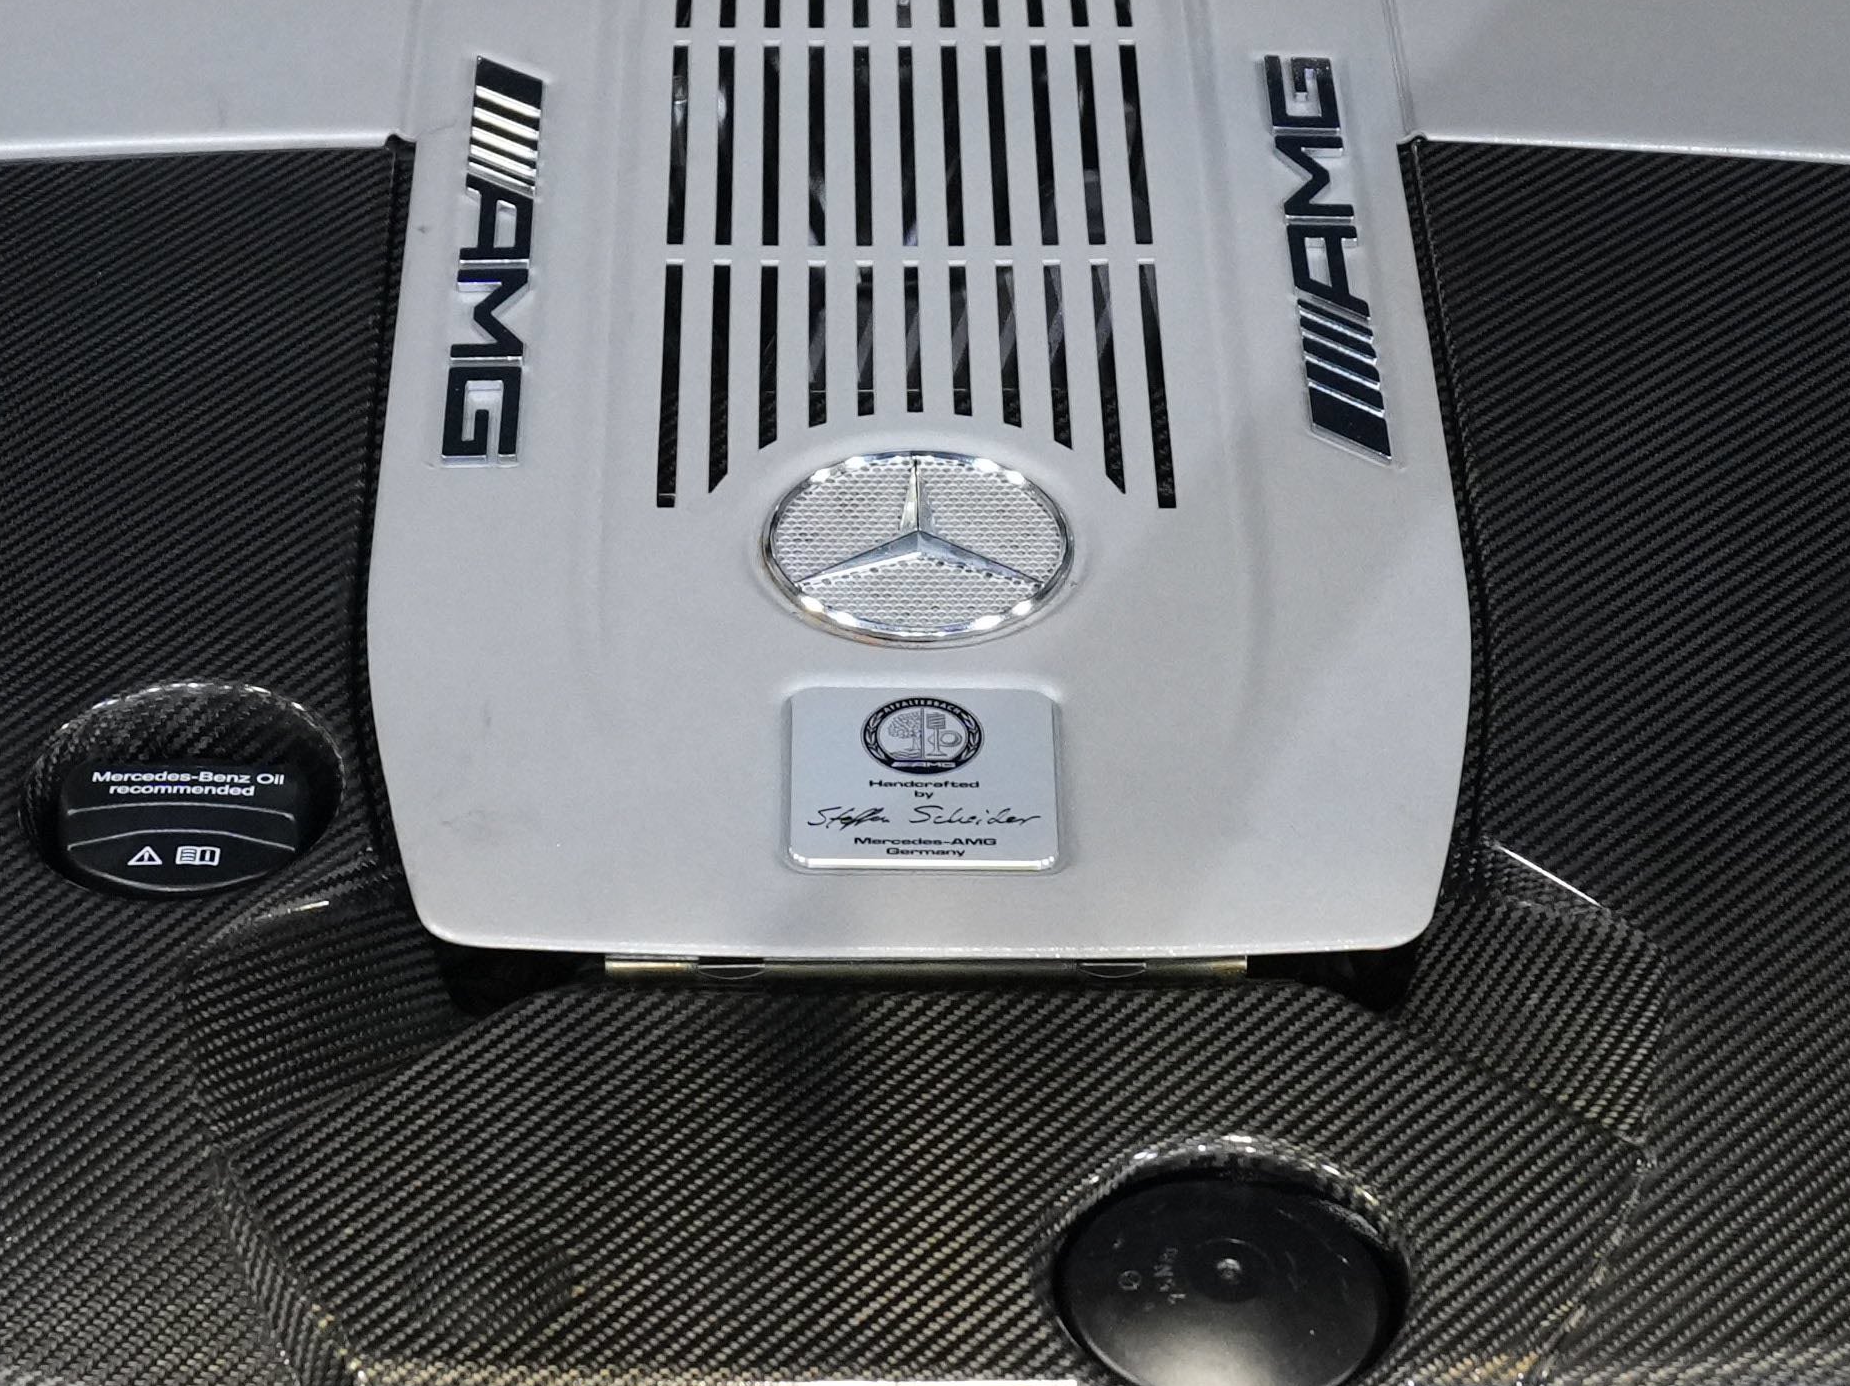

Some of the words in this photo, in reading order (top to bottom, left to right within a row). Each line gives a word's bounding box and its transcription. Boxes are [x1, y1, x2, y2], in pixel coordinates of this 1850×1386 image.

[1262, 53, 1371, 321] AMG
[439, 176, 535, 467] AMG
[91, 770, 251, 784] Mercedes-Benz
[256, 773, 285, 786] Oil
[868, 779, 980, 789] Handcrafted
[109, 783, 256, 797] recommended
[914, 790, 934, 799] by
[853, 836, 998, 846] Mercedes-AMG
[885, 847, 966, 857] Germany
